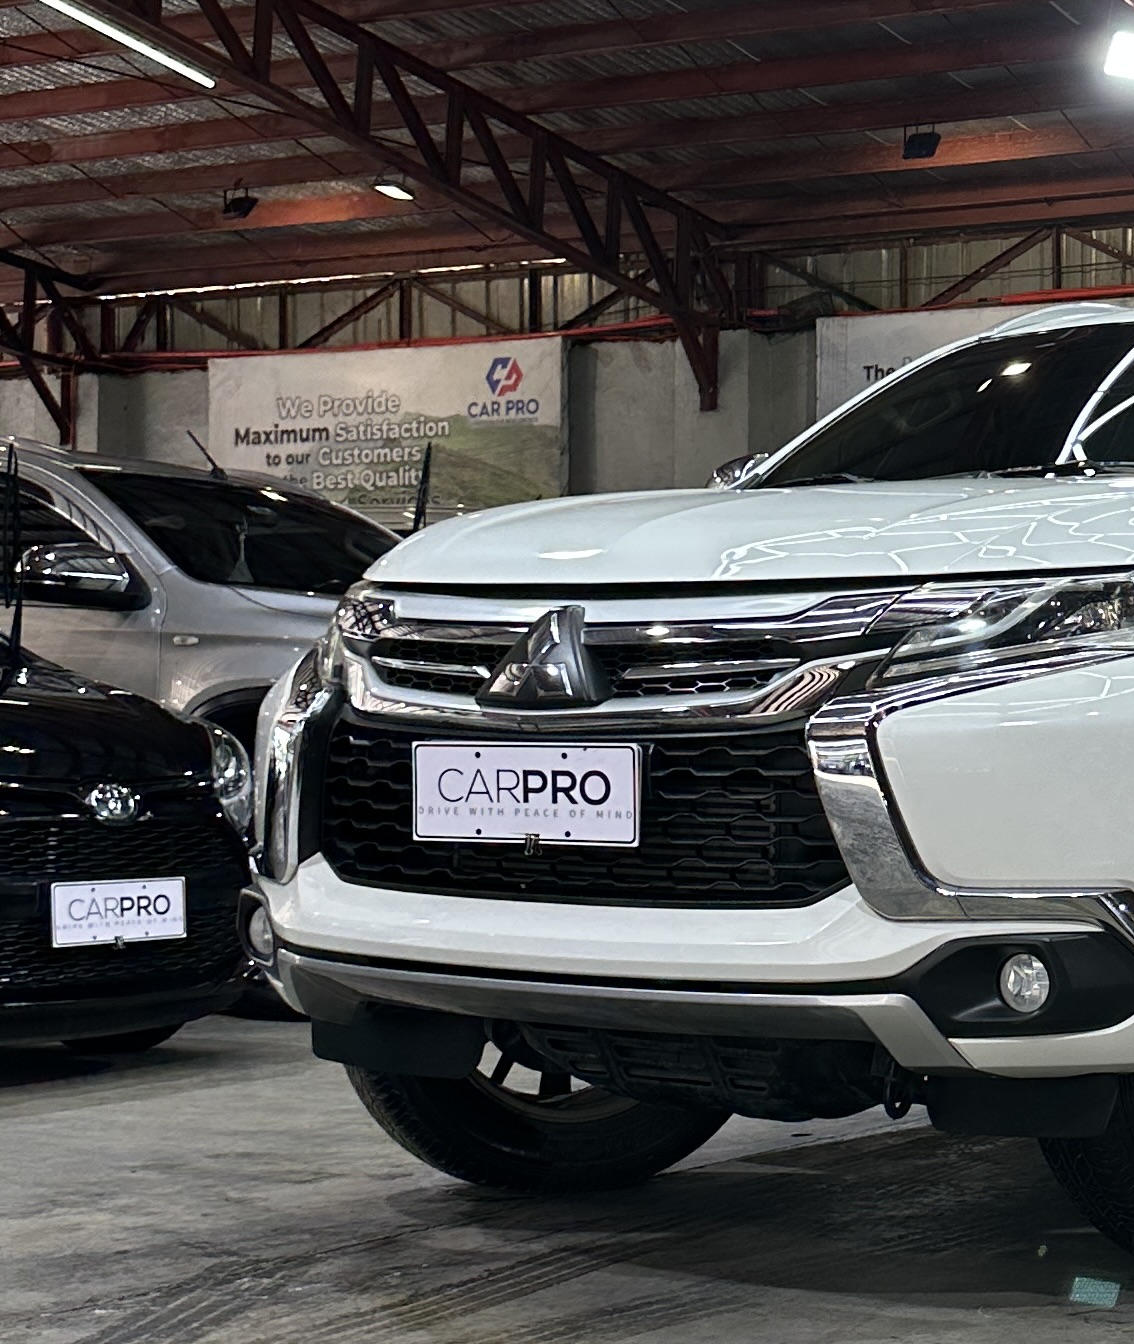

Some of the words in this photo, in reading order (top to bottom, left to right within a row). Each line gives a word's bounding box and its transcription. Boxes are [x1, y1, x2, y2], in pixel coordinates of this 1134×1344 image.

[276, 396, 314, 420] We
[318, 389, 401, 418] Provide
[467, 401, 501, 419] CAR
[505, 399, 540, 416] PRO
[234, 424, 330, 447] Maximum
[333, 415, 450, 442] Satisfaction
[266, 452, 281, 467] to
[286, 453, 311, 465] our
[318, 444, 421, 467] Customers
[312, 471, 353, 491] Best
[360, 466, 423, 492] Qualit
[437, 768, 611, 806] CARPRO
[418, 806, 459, 816] DRIVE
[469, 807, 505, 817] WITH
[514, 807, 559, 818] PEACE
[569, 809, 586, 818] OF
[595, 810, 633, 820] MIND
[68, 894, 171, 921] CARPRO
